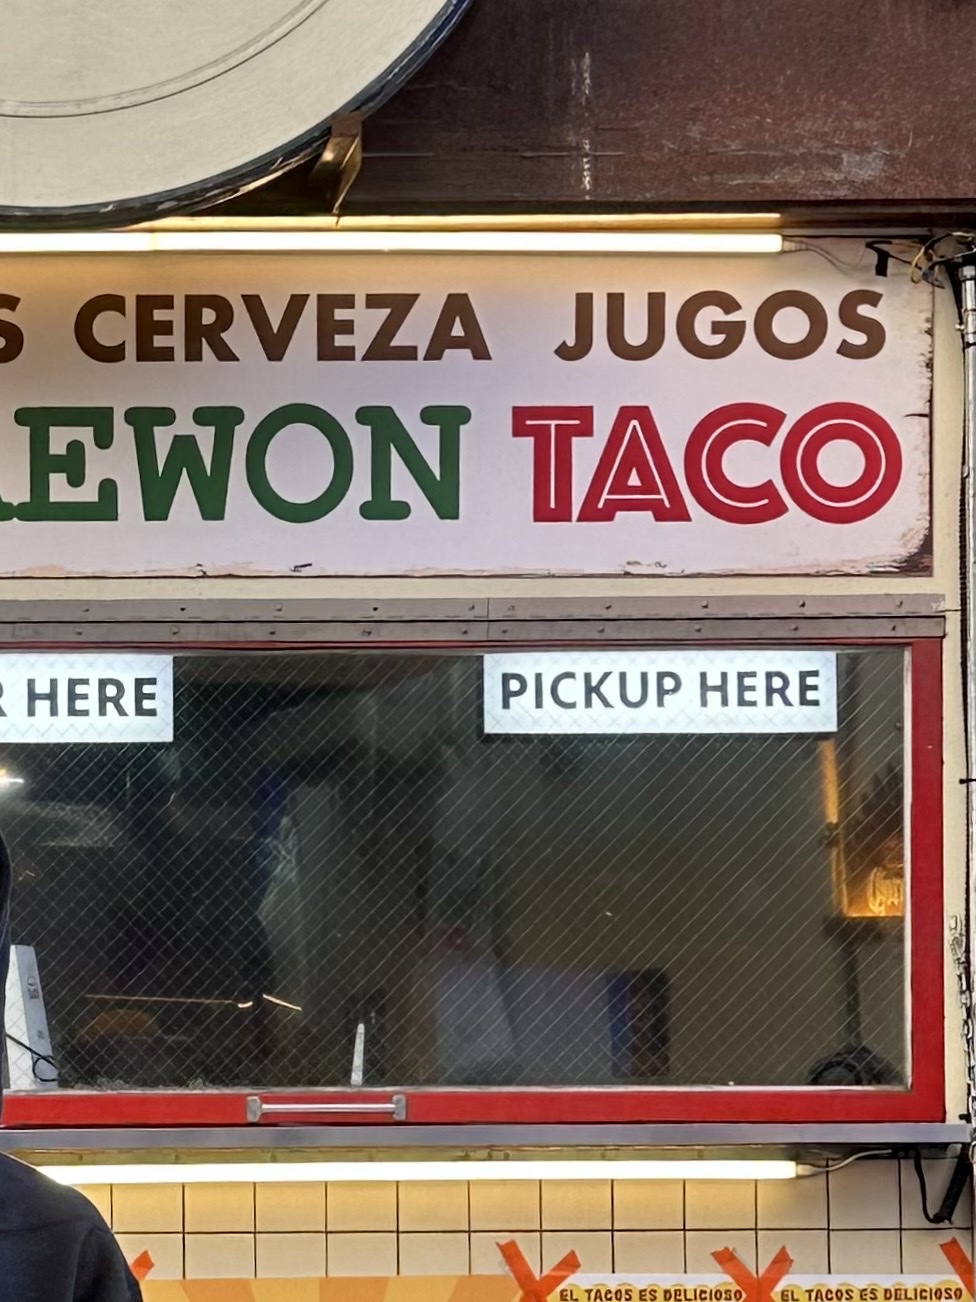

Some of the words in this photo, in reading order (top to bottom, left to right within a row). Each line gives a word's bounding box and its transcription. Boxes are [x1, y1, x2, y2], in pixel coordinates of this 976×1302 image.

[73, 291, 491, 363] CERVEZA
[553, 289, 887, 361] JUGOS
[512, 402, 903, 524] TACO
[26, 676, 160, 719] HERE
[500, 670, 683, 711] PICKUP
[699, 669, 822, 709] HERE
[559, 1288, 578, 1302] EL
[585, 1289, 633, 1302] TACOS
[639, 1289, 657, 1302] ES
[663, 1288, 743, 1302] DELICIOSO
[781, 1289, 799, 1302] EL
[805, 1288, 854, 1302] TACOS
[860, 1288, 878, 1301] ES
[884, 1287, 963, 1301] DELICIOSO
